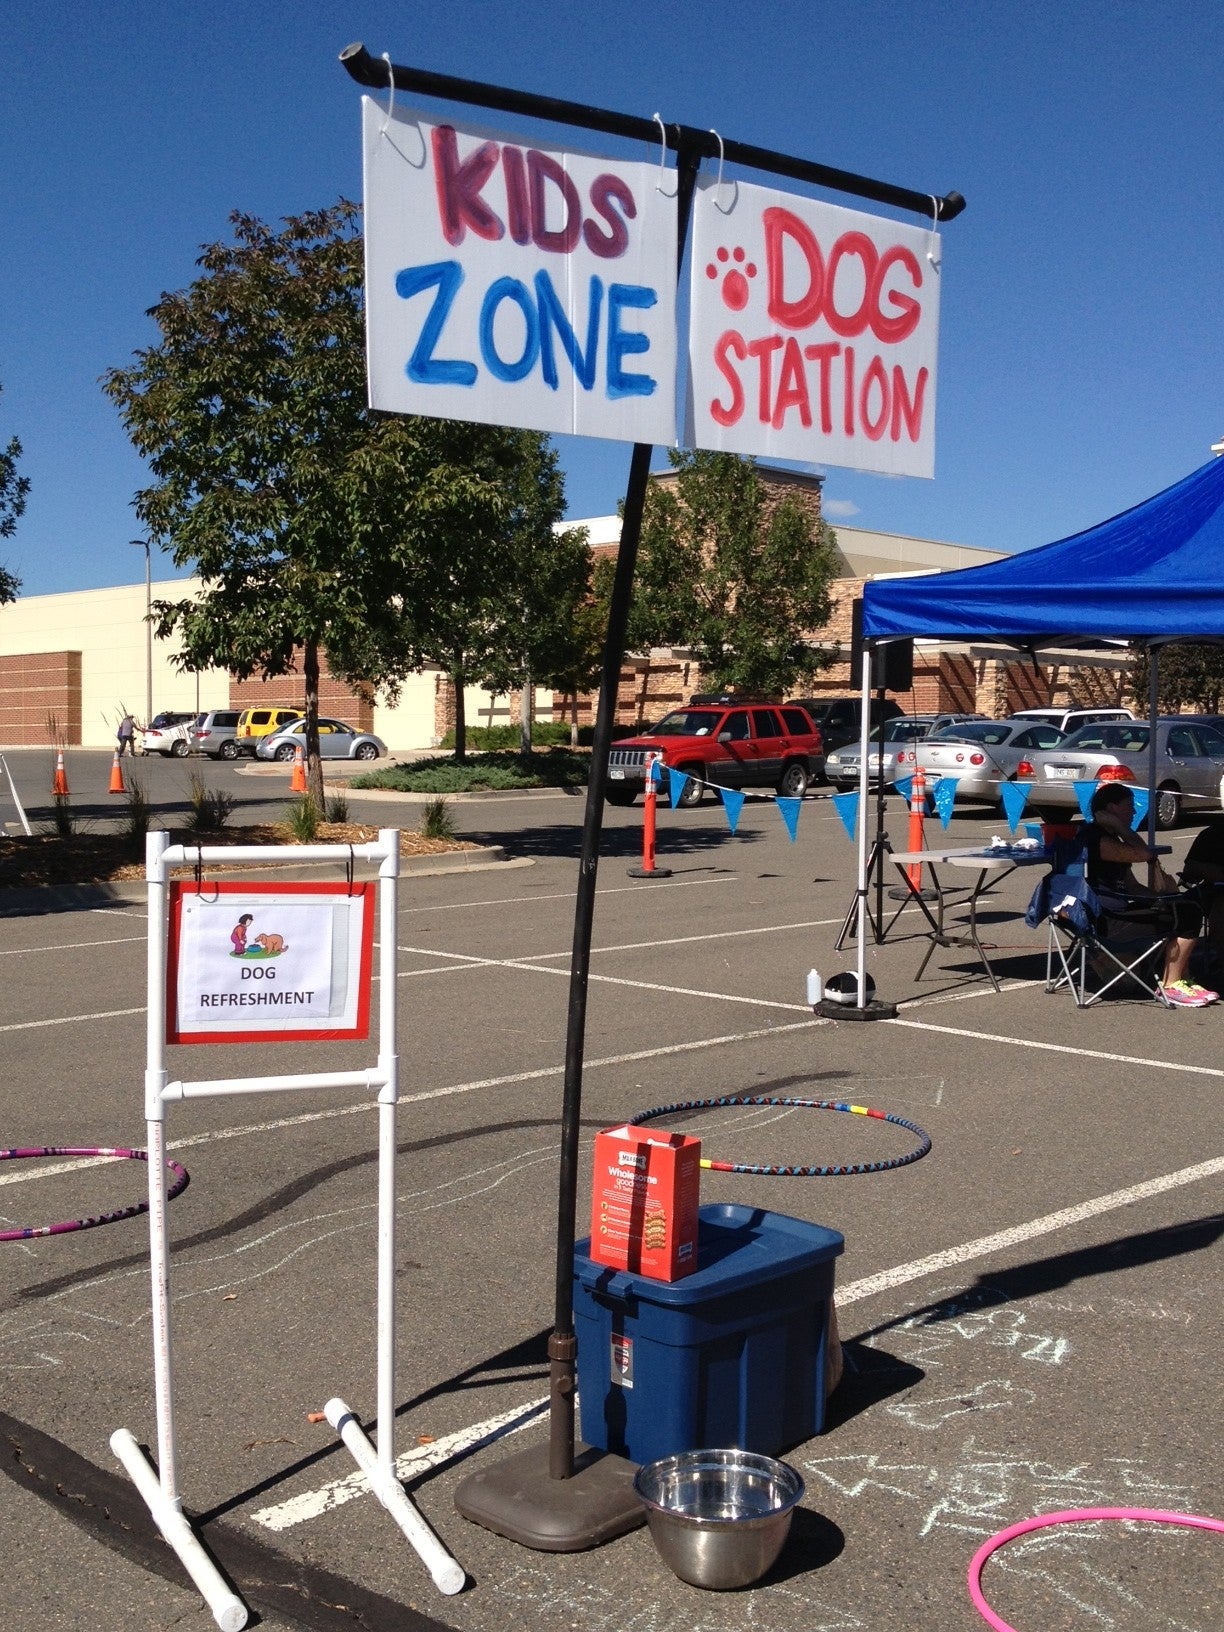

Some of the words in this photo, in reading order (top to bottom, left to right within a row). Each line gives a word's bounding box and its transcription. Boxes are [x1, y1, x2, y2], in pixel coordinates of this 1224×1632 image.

[431, 123, 638, 259] KIDS
[395, 260, 658, 400] ZONE
[761, 206, 923, 344] DOG
[709, 329, 929, 443] STATION
[200, 991, 315, 1007] REFRESHMENT
[241, 966, 276, 980] DOG
